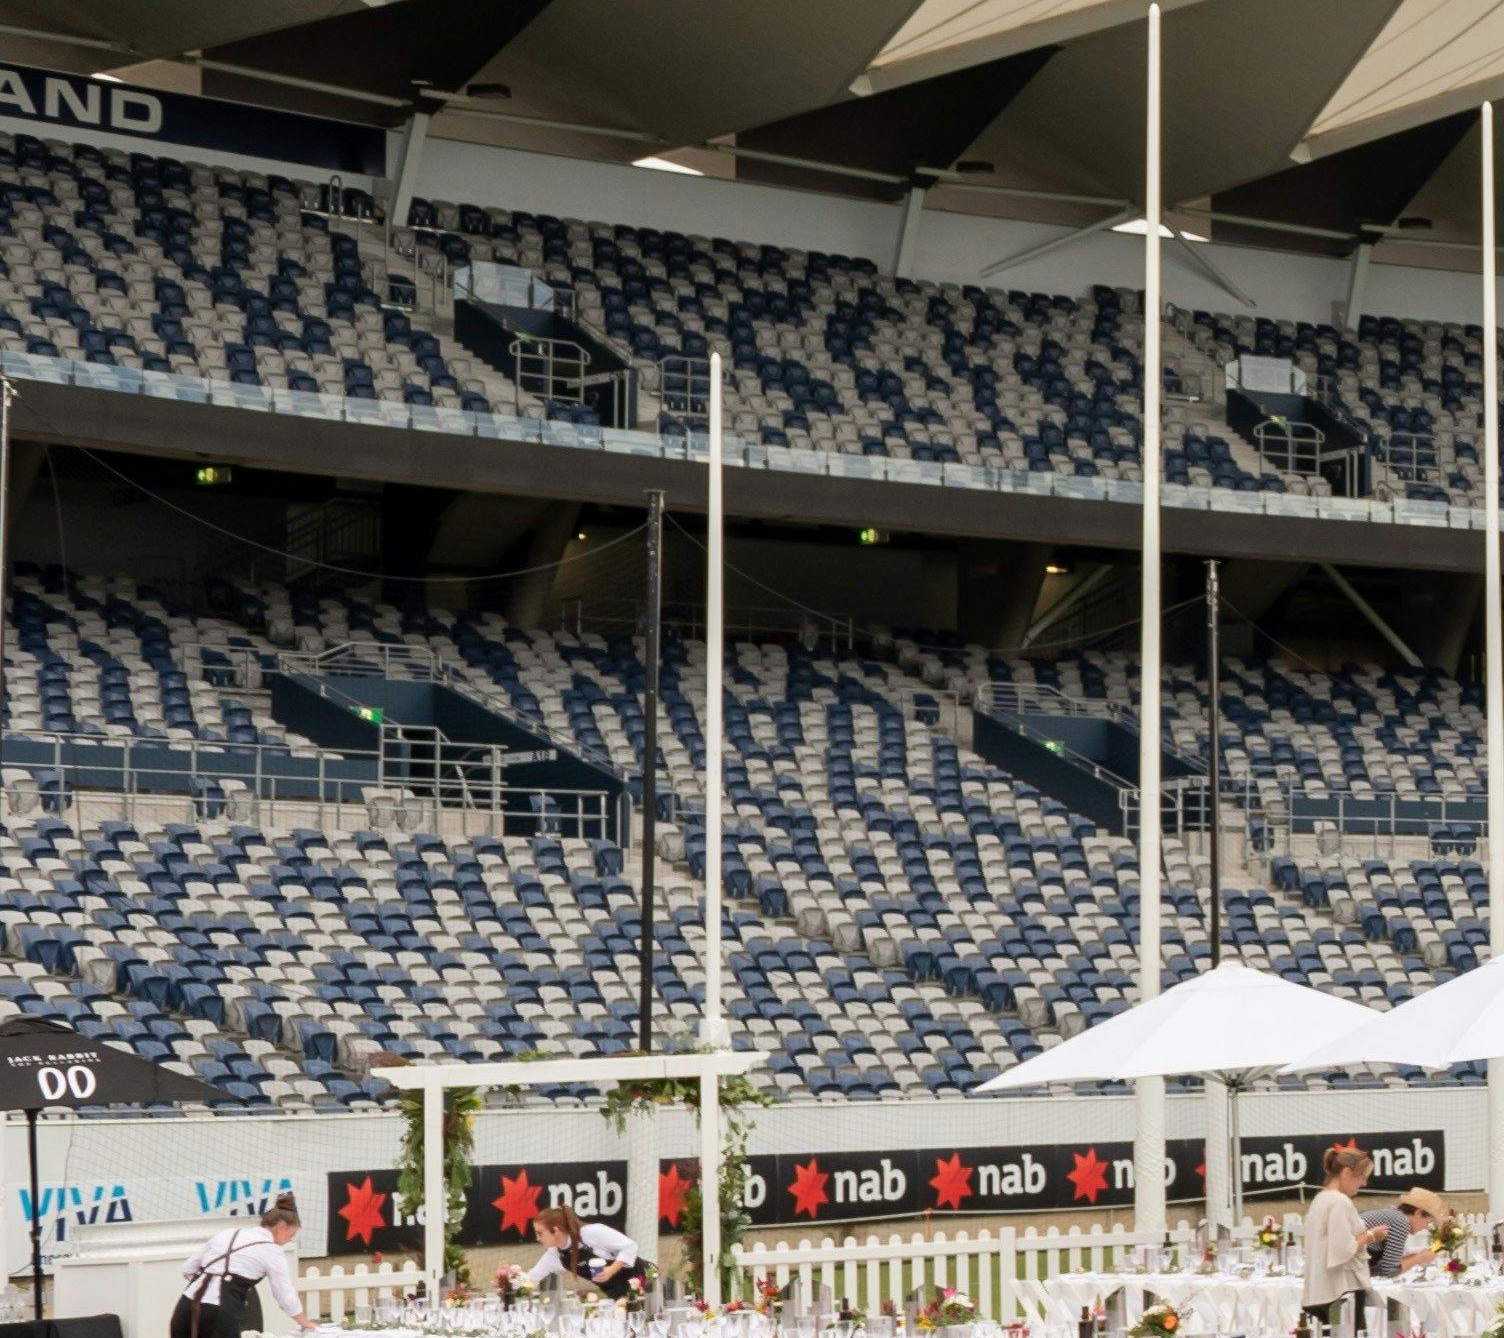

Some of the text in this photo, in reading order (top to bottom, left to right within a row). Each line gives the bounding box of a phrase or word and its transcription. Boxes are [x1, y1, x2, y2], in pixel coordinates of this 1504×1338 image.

[0, 69, 164, 133] AND
[978, 1153, 1047, 1196] nab
[1241, 1143, 1307, 1182] nab
[1374, 1138, 1435, 1177] nab
[548, 1171, 623, 1216] nab
[834, 1159, 907, 1203] nab
[19, 1185, 132, 1241] VIVA
